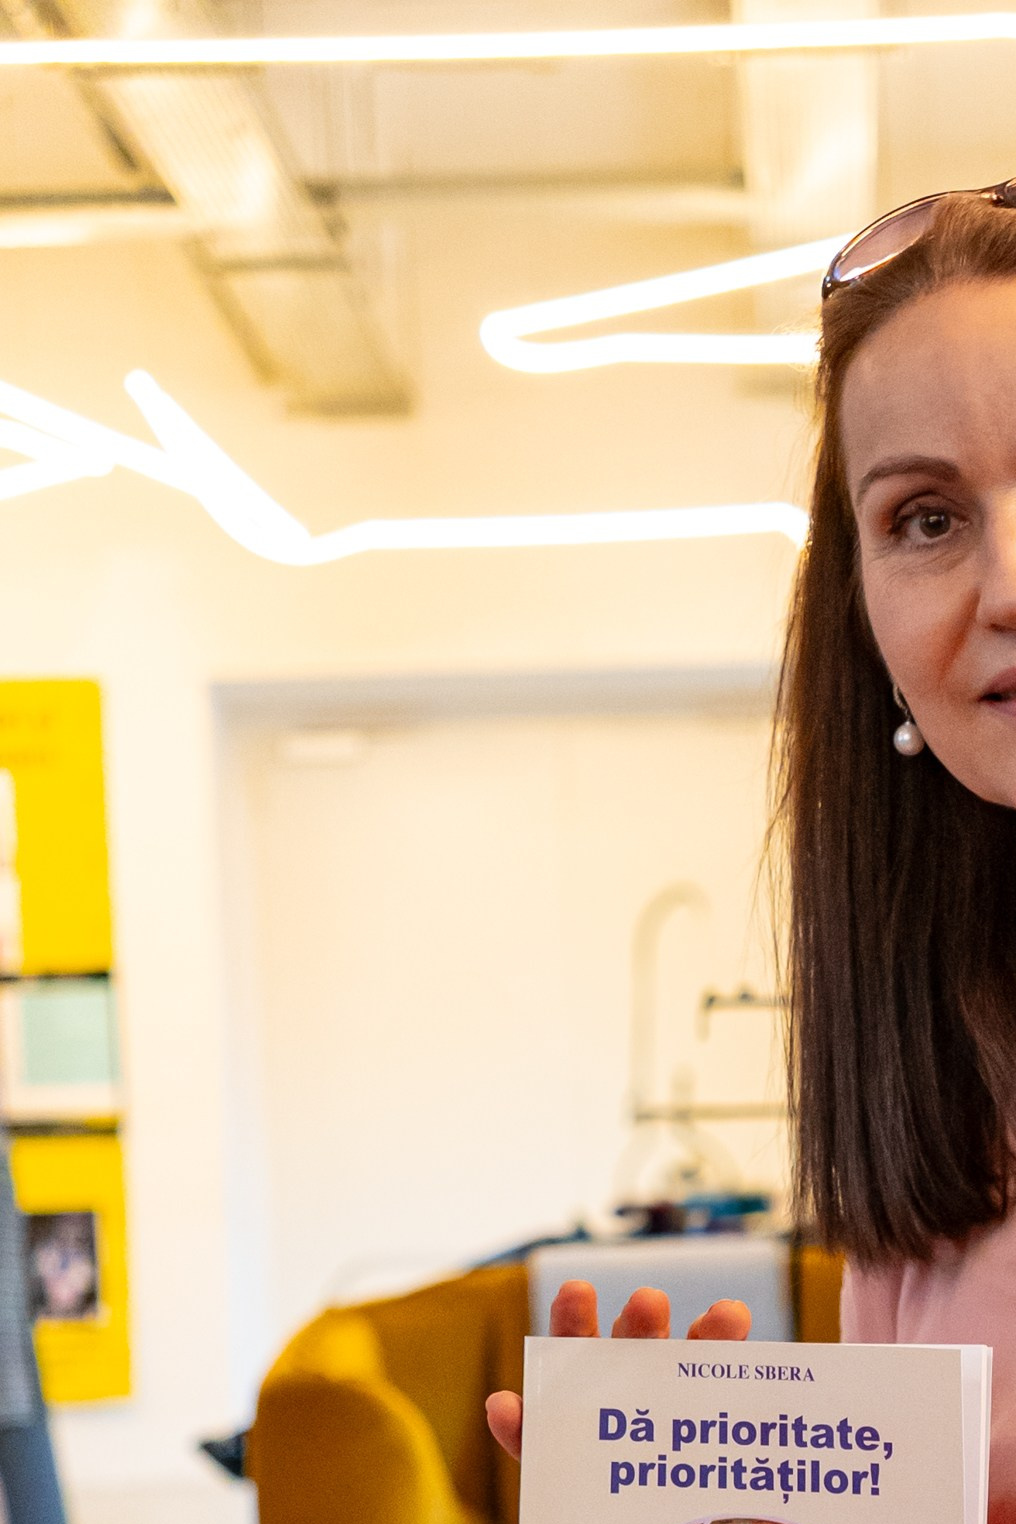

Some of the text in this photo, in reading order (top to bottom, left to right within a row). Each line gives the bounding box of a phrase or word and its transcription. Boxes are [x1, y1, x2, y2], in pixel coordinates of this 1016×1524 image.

[677, 1362, 815, 1383] NICOLE SBERA
[599, 1408, 893, 1461] Dă prioritate,
[610, 1454, 880, 1505] priorităților!
